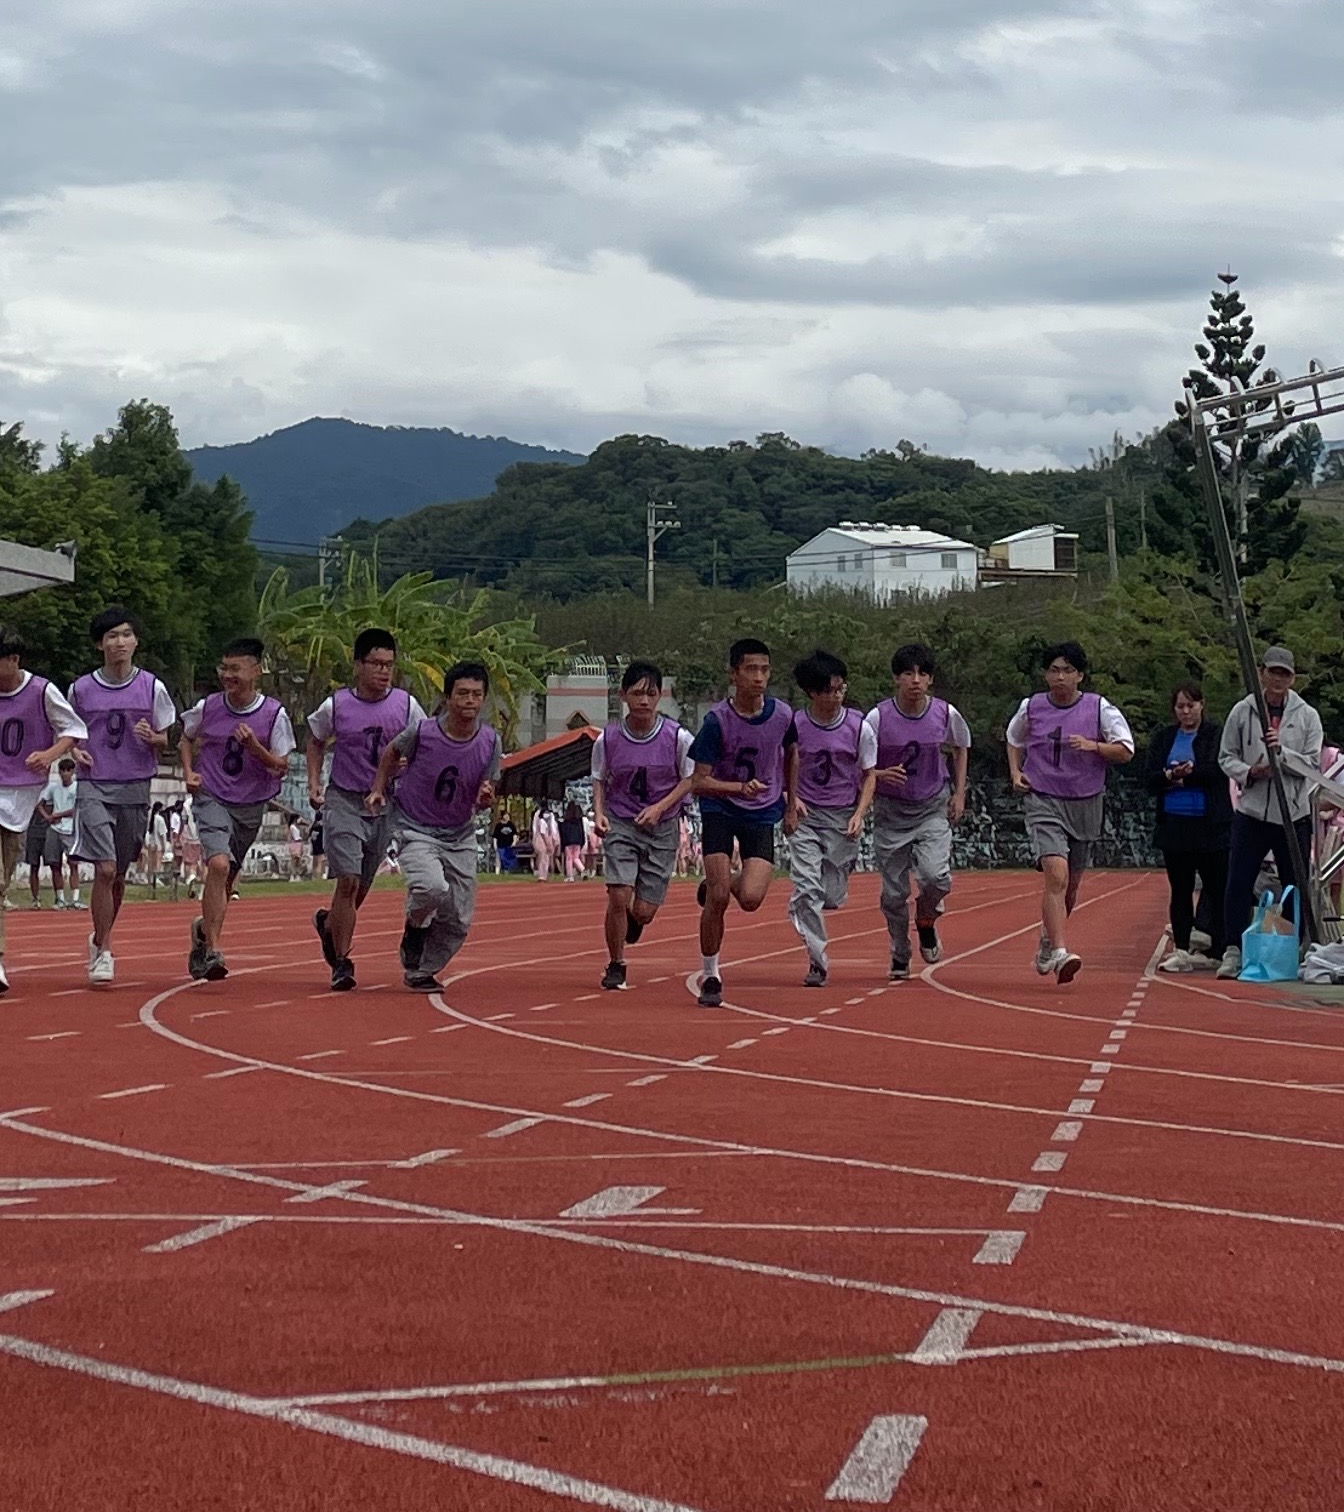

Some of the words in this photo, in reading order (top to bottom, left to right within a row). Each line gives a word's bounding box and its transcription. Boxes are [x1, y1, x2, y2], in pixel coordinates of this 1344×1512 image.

[106, 708, 127, 750] 9
[1046, 726, 1062, 767] 1
[222, 736, 244, 776] 8
[734, 746, 759, 782] 5
[812, 750, 832, 787] 3
[901, 739, 921, 776] 2
[435, 764, 458, 803] 6
[629, 766, 648, 803] 4
